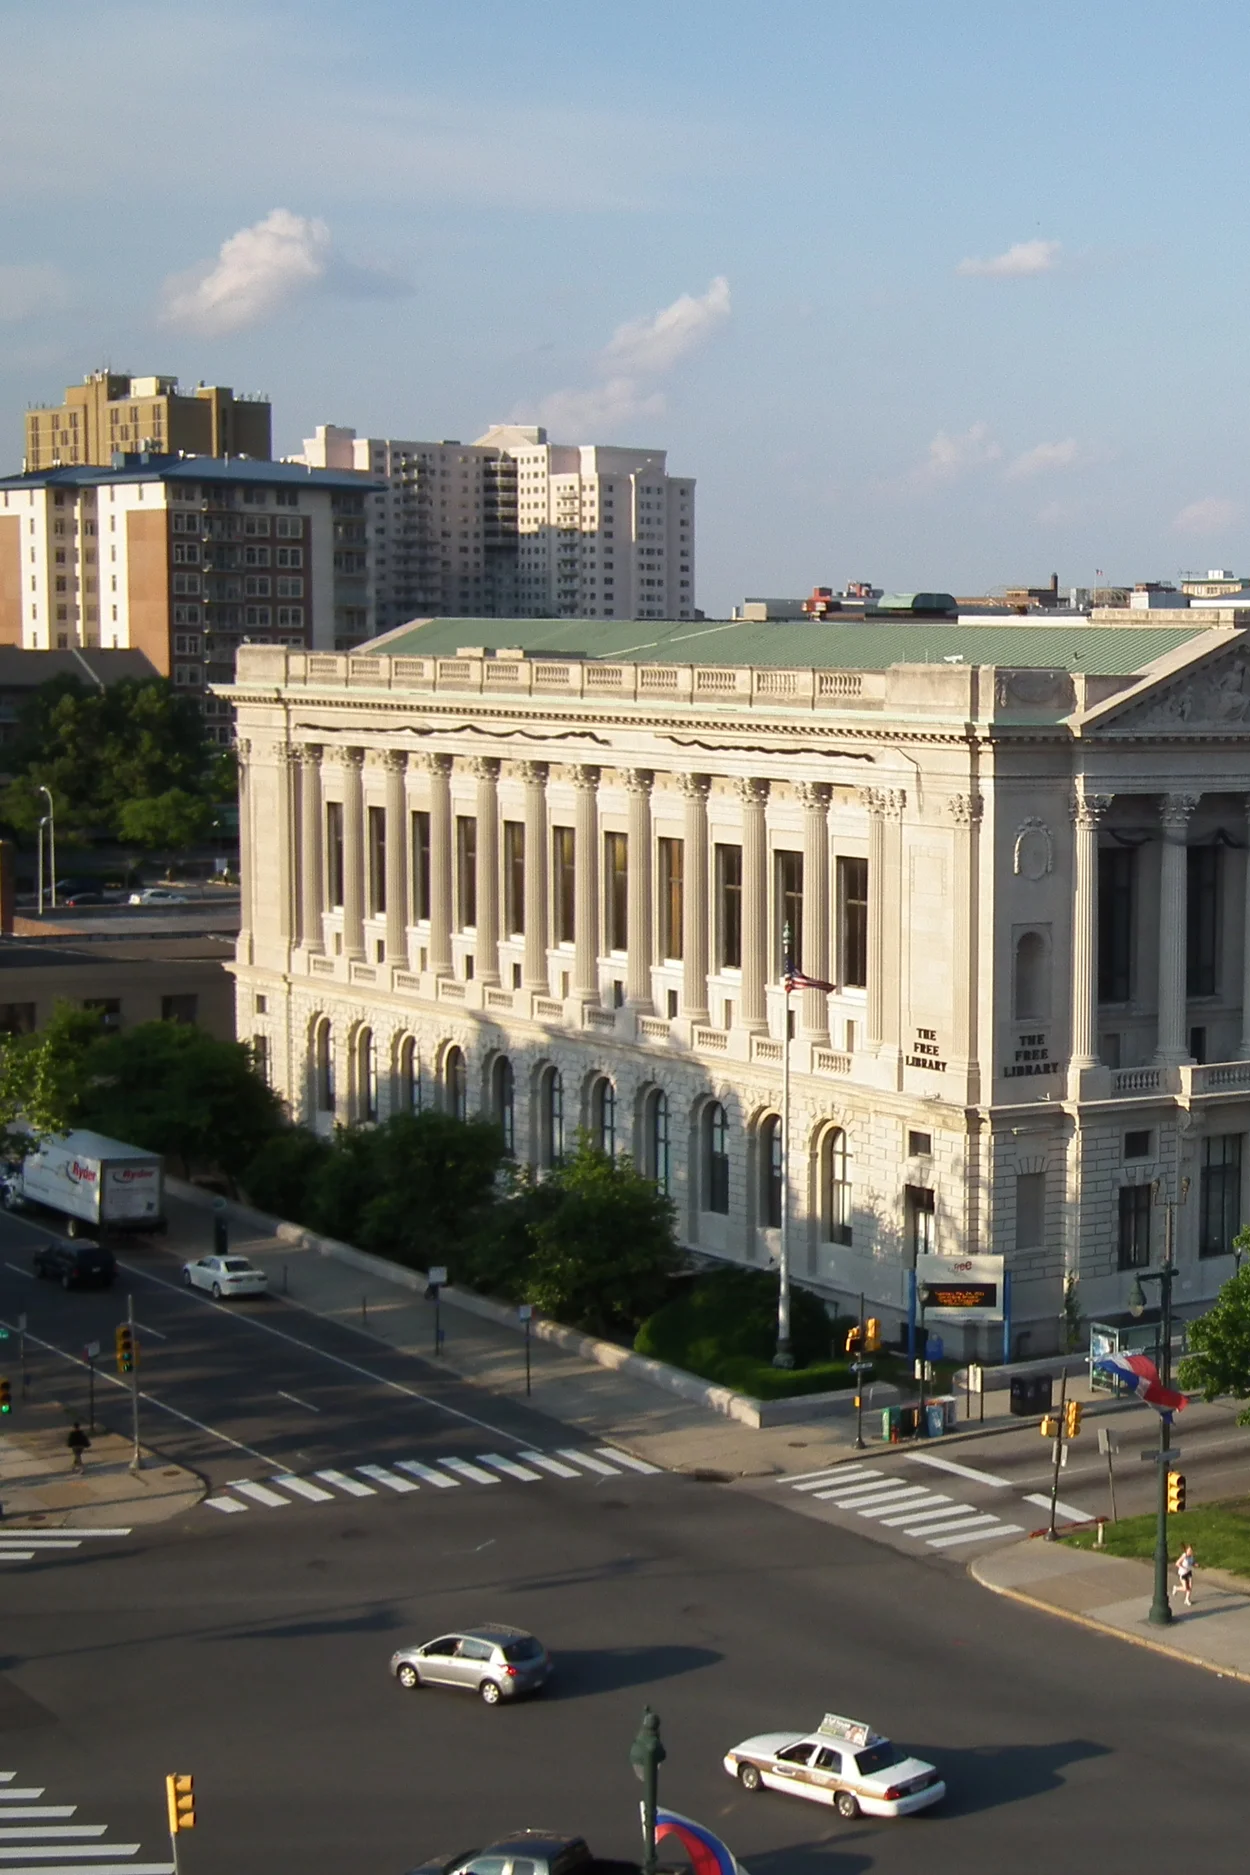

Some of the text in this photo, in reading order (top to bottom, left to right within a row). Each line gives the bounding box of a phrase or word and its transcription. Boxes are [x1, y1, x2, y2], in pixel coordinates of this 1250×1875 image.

[916, 1027, 937, 1041] THE
[1019, 1033, 1046, 1047] THE
[913, 1042, 940, 1057] FREE
[1015, 1048, 1049, 1062] FREE
[905, 1055, 948, 1073] LIBRARY
[1004, 1062, 1059, 1078] LIBRARY
[72, 1160, 97, 1182] Ryder
[122, 1168, 154, 1181] Ryder
[953, 1260, 972, 1271] free
